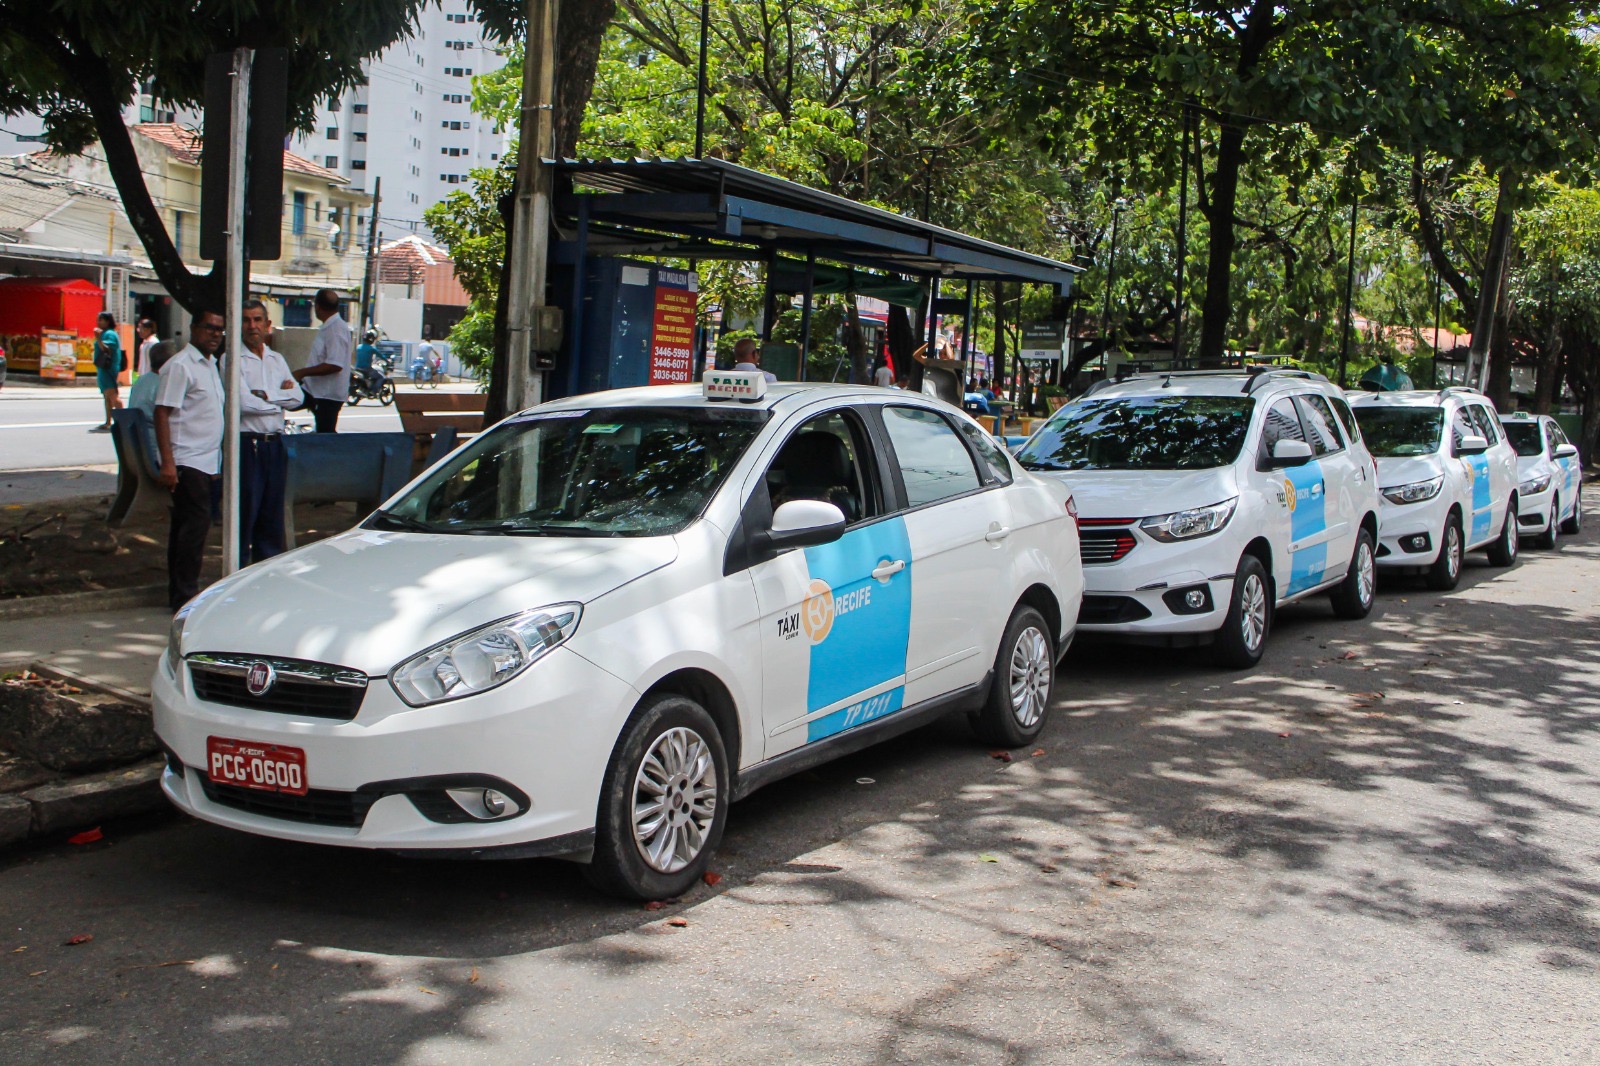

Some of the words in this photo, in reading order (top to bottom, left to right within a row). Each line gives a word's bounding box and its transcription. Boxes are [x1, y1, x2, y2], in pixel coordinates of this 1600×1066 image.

[655, 346, 689, 358] 3446-5999
[654, 358, 688, 369] 3446-6071
[653, 370, 688, 381] 3036-6361
[708, 385, 752, 394] RECIFE
[777, 611, 799, 637] TÁXI
[834, 586, 872, 617] RECIFE
[842, 704, 862, 727] TP
[862, 692, 892, 720] 1211
